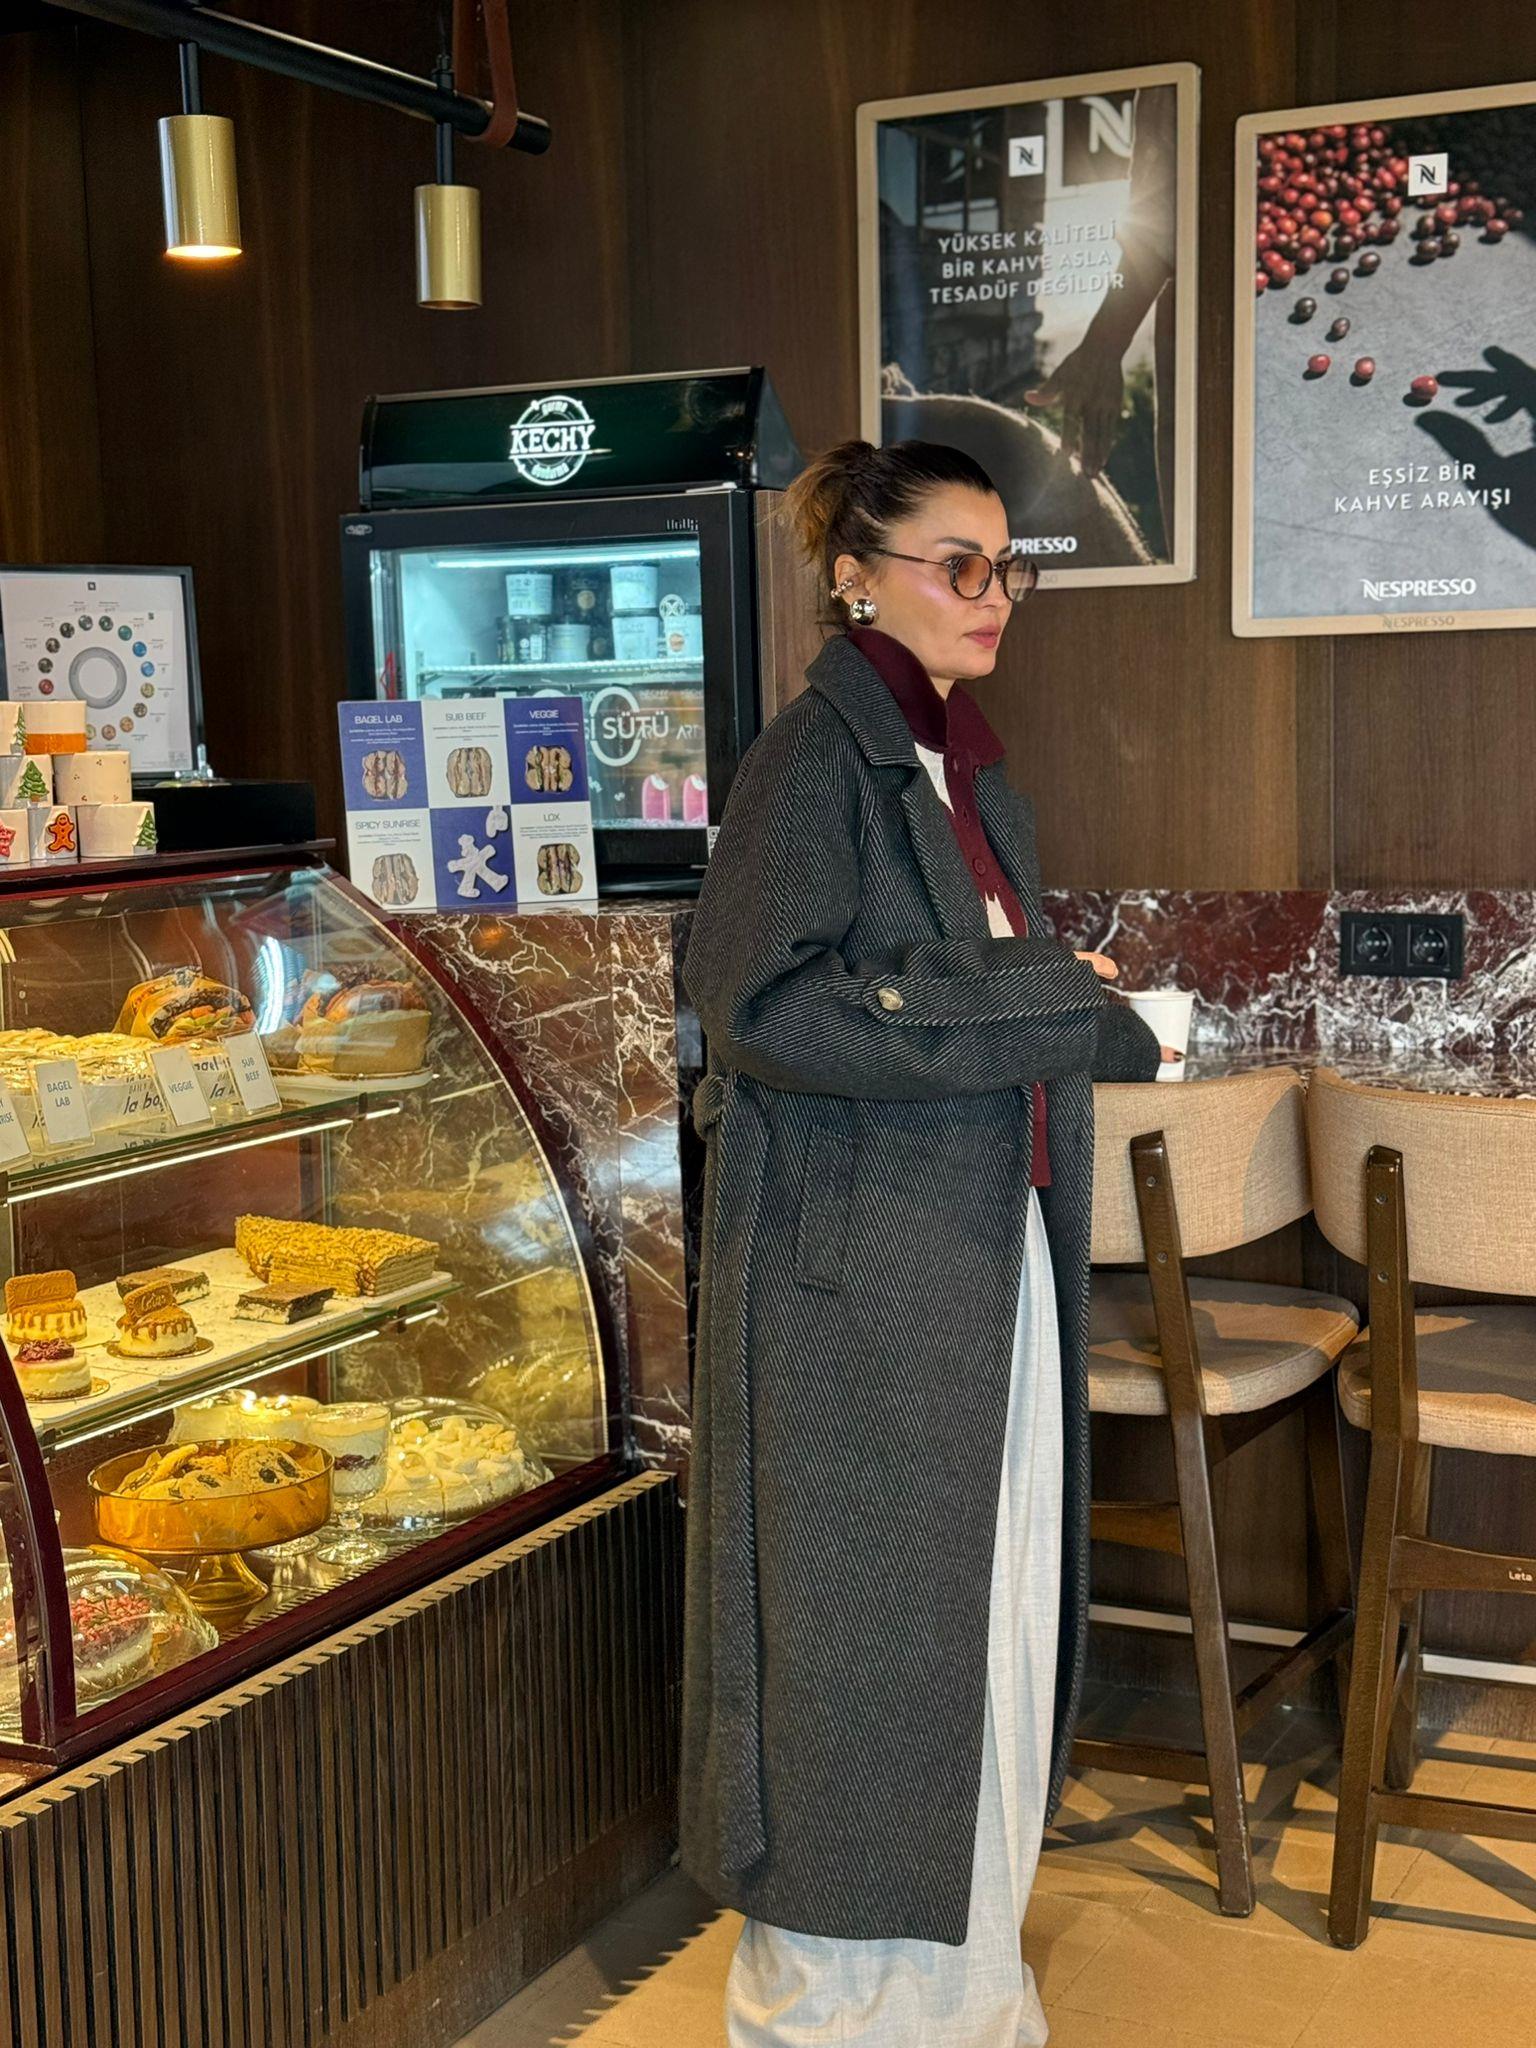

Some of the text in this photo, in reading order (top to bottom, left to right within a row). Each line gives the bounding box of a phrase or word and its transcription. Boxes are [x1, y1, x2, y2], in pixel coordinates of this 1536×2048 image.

[1015, 145, 1039, 167] N
[1414, 163, 1442, 186] N
[938, 220, 1118, 254] YÜKSEK KALİTELİ
[942, 248, 1113, 280] BİR KAHVE ASLA
[929, 270, 1124, 305] TESADÜF DEĞİLDİR
[509, 424, 596, 455] KECHY
[1369, 460, 1476, 489] EŞSİZ BİR
[1334, 488, 1511, 514] KAHVE ARAYIŞI
[1010, 536, 1078, 555] PRESSO
[1361, 577, 1478, 602] NESPRESSO
[1380, 614, 1456, 630] NESPRESSO
[354, 714, 403, 725] BAGEL LAB
[445, 711, 487, 721] SUB BEEF
[529, 709, 560, 719] VEGGIE
[602, 711, 669, 739] SÜTÜ
[355, 818, 421, 830] SPICY SUNRISE
[542, 812, 561, 822] LOX
[241, 1057, 256, 1068] SUB
[245, 1070, 260, 1082] BEEF
[47, 1081, 72, 1093] BAGEL
[168, 1080, 194, 1094] VEGGIE
[55, 1096, 71, 1108] LAB
